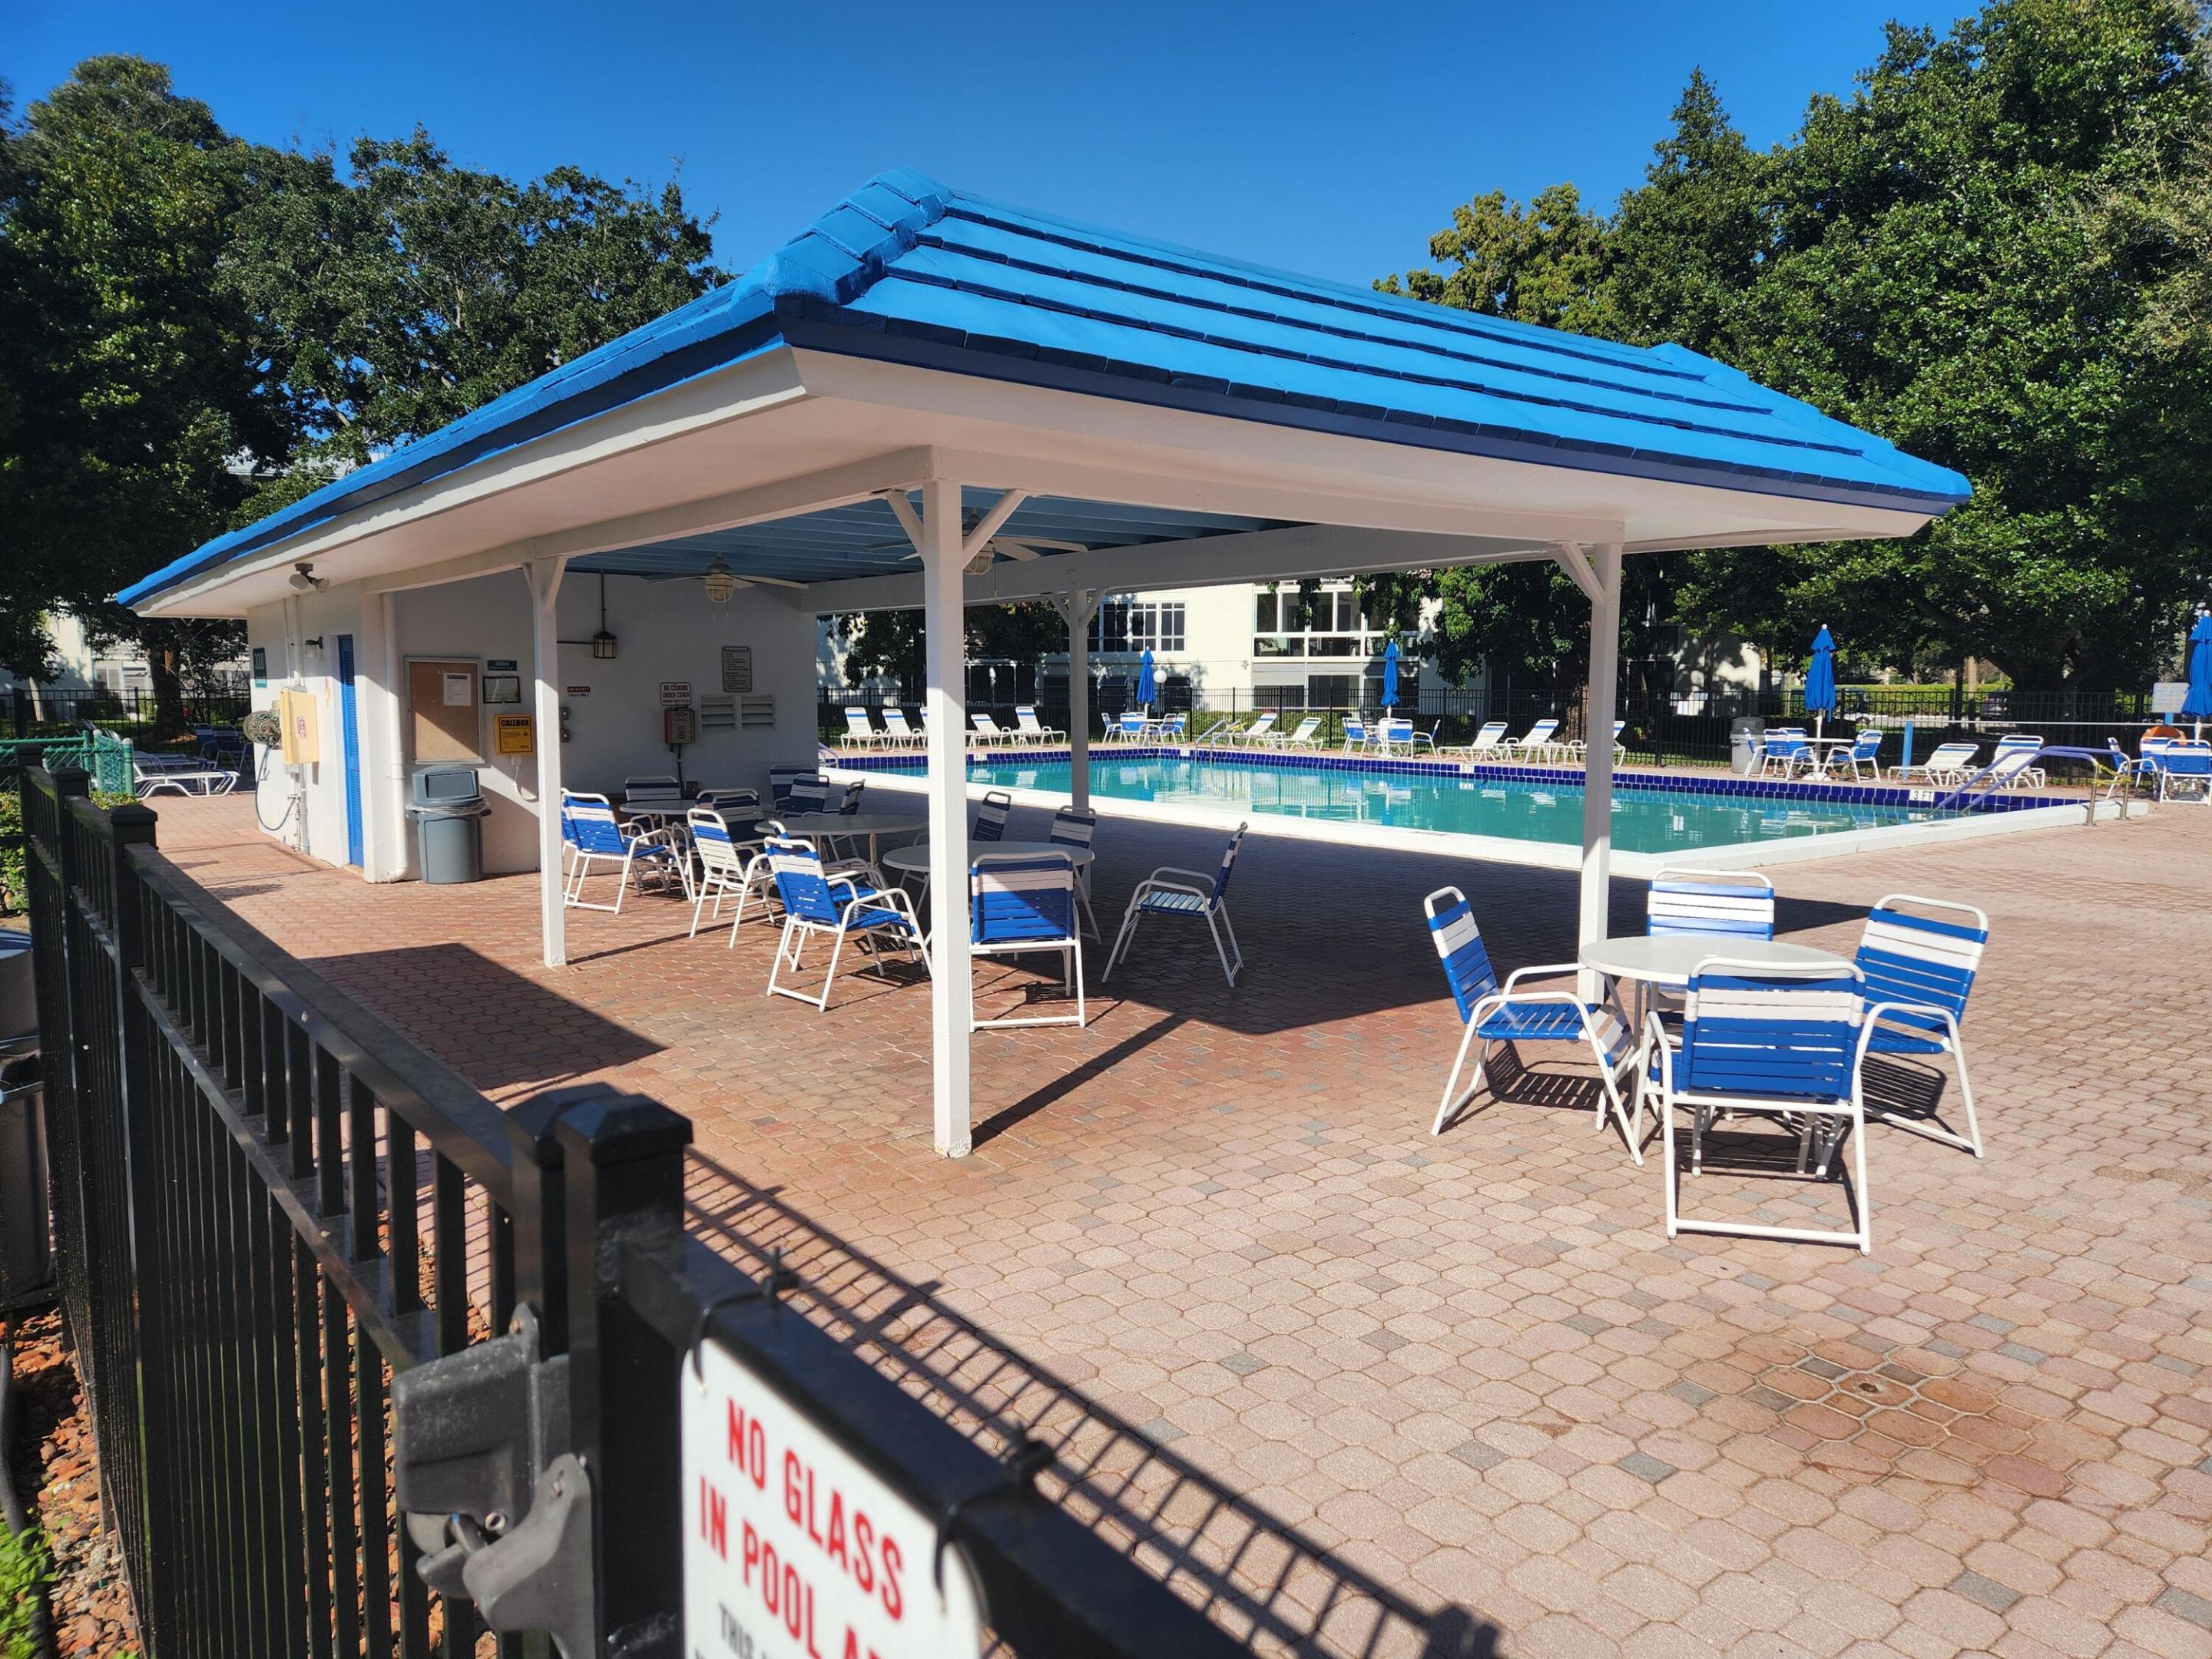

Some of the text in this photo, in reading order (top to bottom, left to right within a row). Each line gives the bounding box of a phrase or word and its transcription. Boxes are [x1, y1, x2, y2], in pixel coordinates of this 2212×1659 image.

[1913, 790, 1933, 800] 3 FT
[700, 1475, 823, 1659] IN POOL
[727, 1396, 904, 1623] NO GLASS
